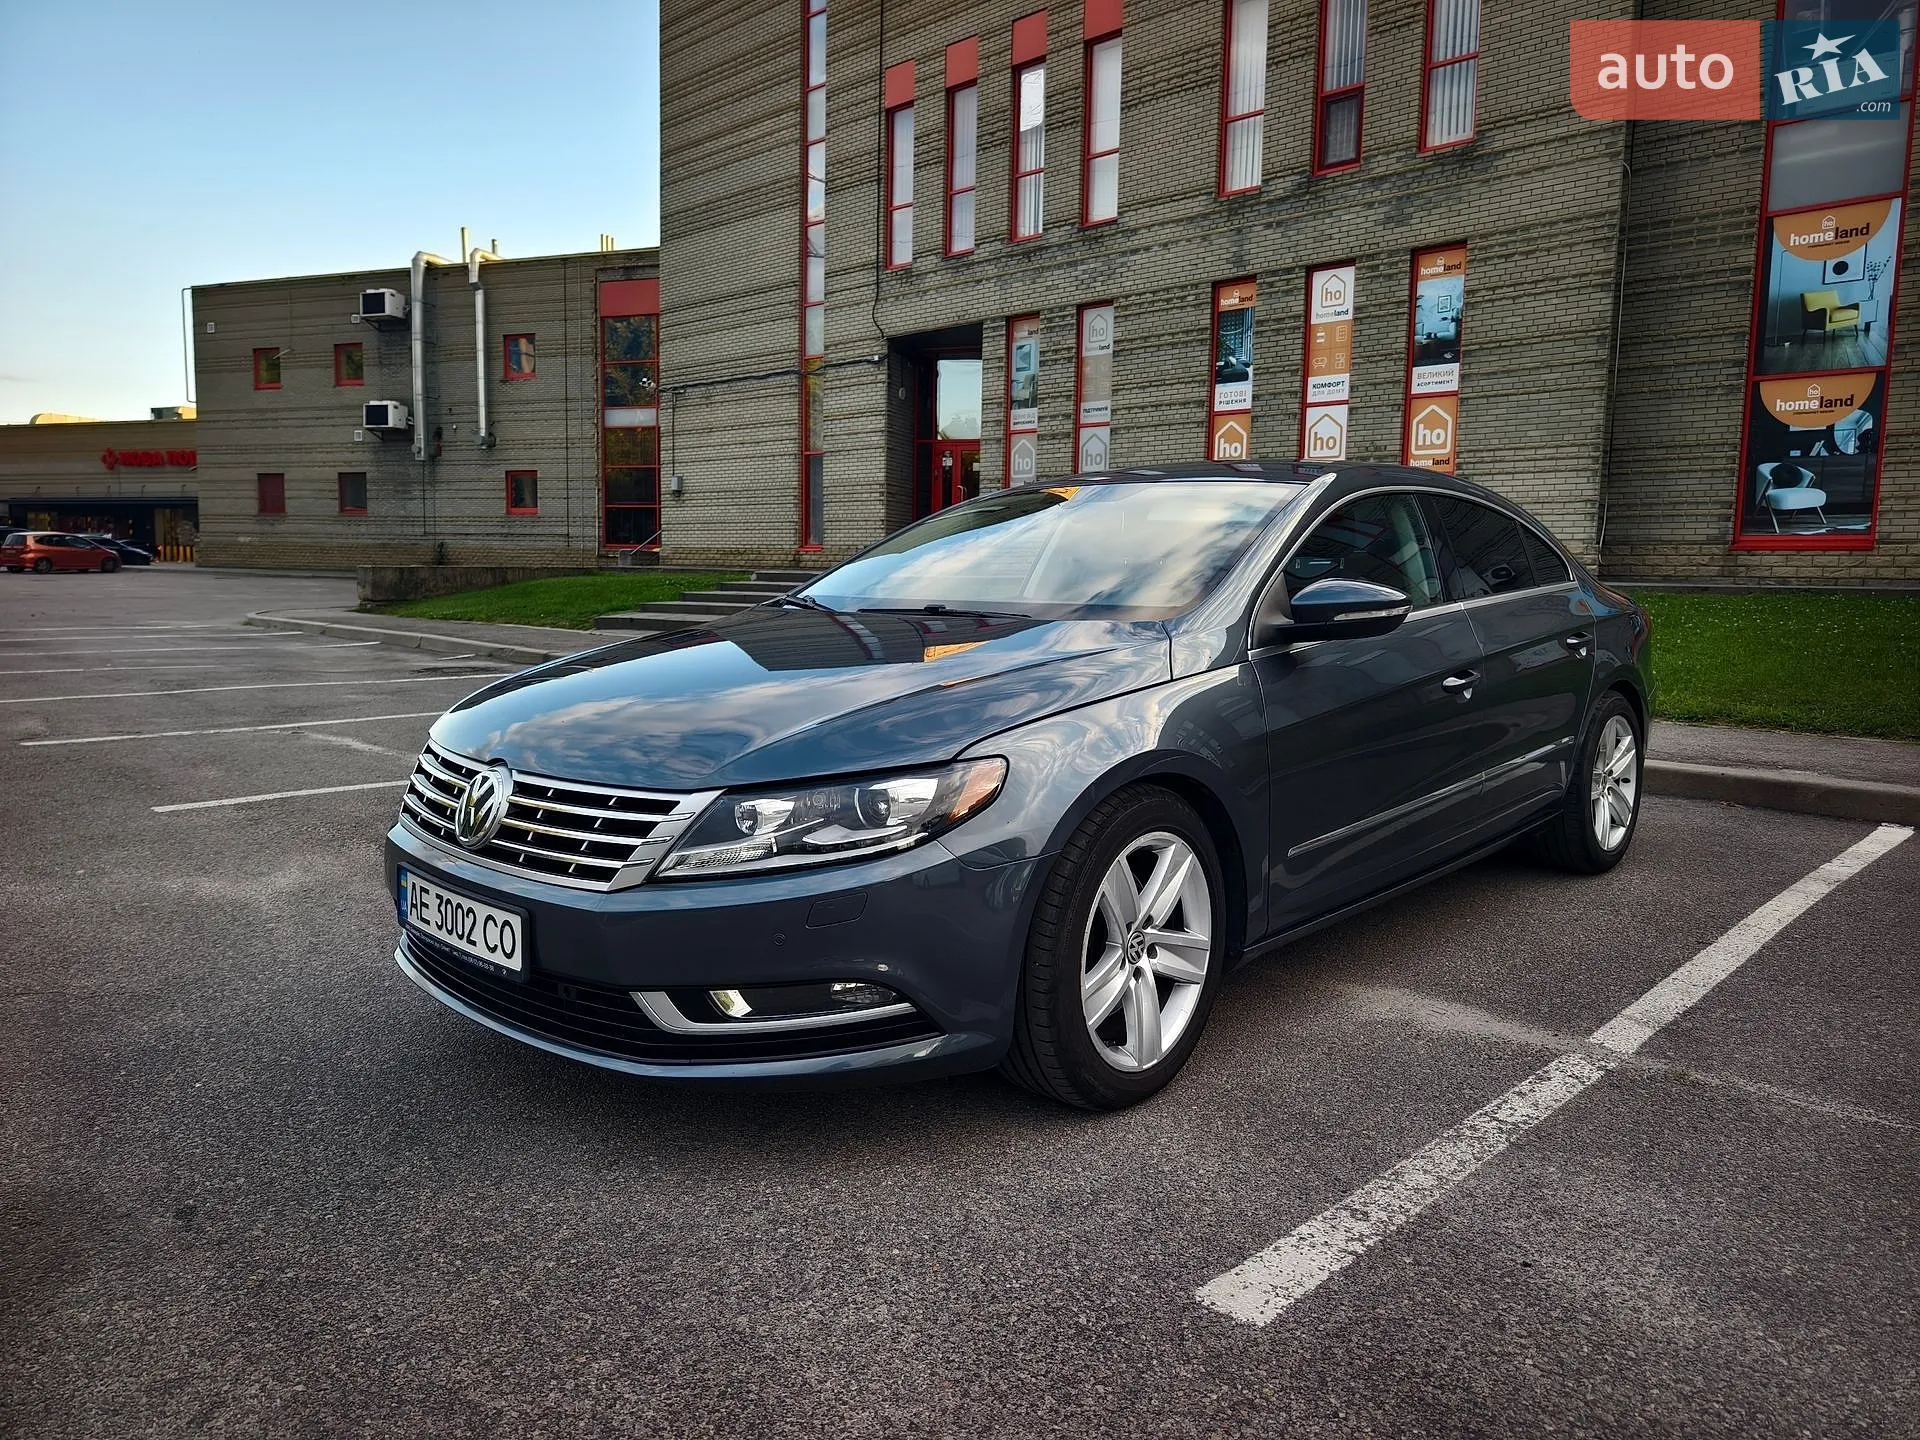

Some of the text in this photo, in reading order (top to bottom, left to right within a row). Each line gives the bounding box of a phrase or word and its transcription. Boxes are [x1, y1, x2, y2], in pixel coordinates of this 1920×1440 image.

[1790, 222, 1870, 246] homeland
[1420, 261, 1462, 276] homeland
[1325, 288, 1342, 302] ho
[1315, 308, 1349, 319] homeland
[1417, 370, 1454, 380] ВЕЛИКИЙ
[1312, 381, 1345, 389] КОМФОРТ
[1775, 394, 1854, 411] homeland
[1313, 431, 1337, 451] ho
[1417, 423, 1446, 446] ho
[1220, 438, 1241, 458] ho
[1014, 454, 1031, 471] ho
[1085, 449, 1103, 467] ho
[409, 881, 431, 926] AE
[435, 892, 477, 947] 3002
[483, 913, 516, 960] CO
